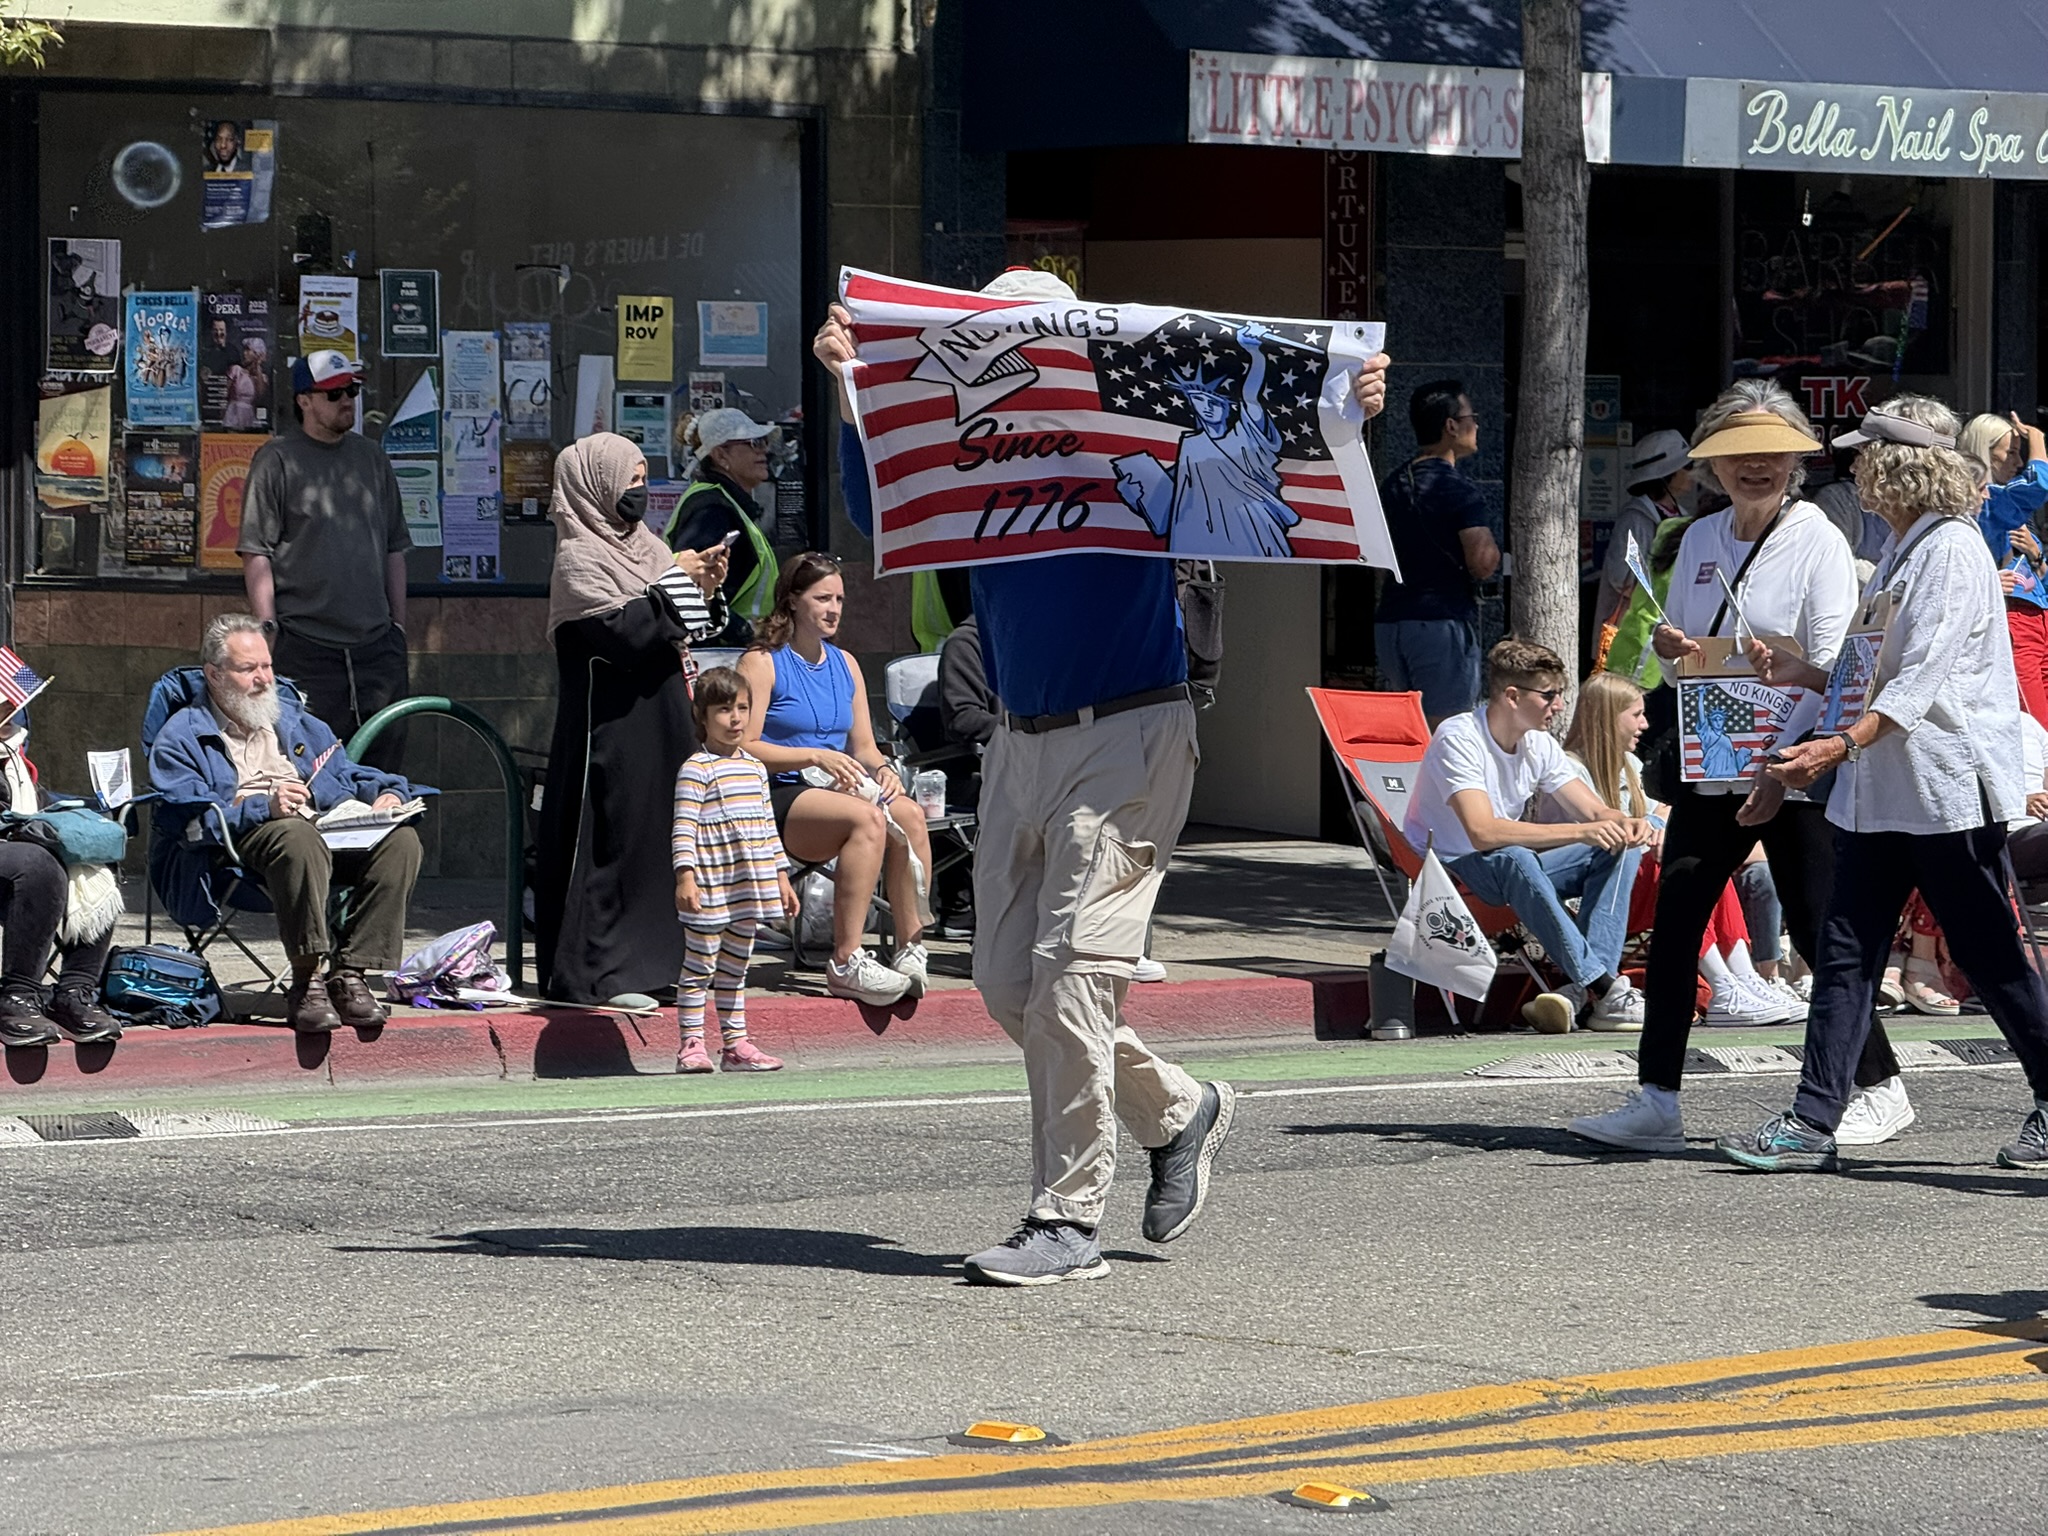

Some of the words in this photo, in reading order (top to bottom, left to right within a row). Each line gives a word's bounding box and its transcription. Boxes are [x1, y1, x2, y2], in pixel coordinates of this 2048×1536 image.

[1207, 69, 1334, 140] LITTLE
[1342, 77, 1492, 149] PSYCHIC
[1746, 88, 1858, 158] Bella
[1859, 95, 1951, 162] Nail
[1959, 106, 2025, 175] Spa
[135, 296, 164, 306] CIRCUS
[165, 296, 189, 307] BELLA
[202, 293, 243, 305] POCKET
[208, 303, 243, 315] OPERA
[625, 304, 664, 322] IMP
[625, 326, 659, 340] ROV
[1005, 307, 1120, 338] INGS
[1800, 375, 1871, 419] TK
[953, 417, 1086, 472] Since
[974, 481, 1100, 544] 1776
[1729, 682, 1749, 697] NO
[1751, 686, 1792, 715] KINGS
